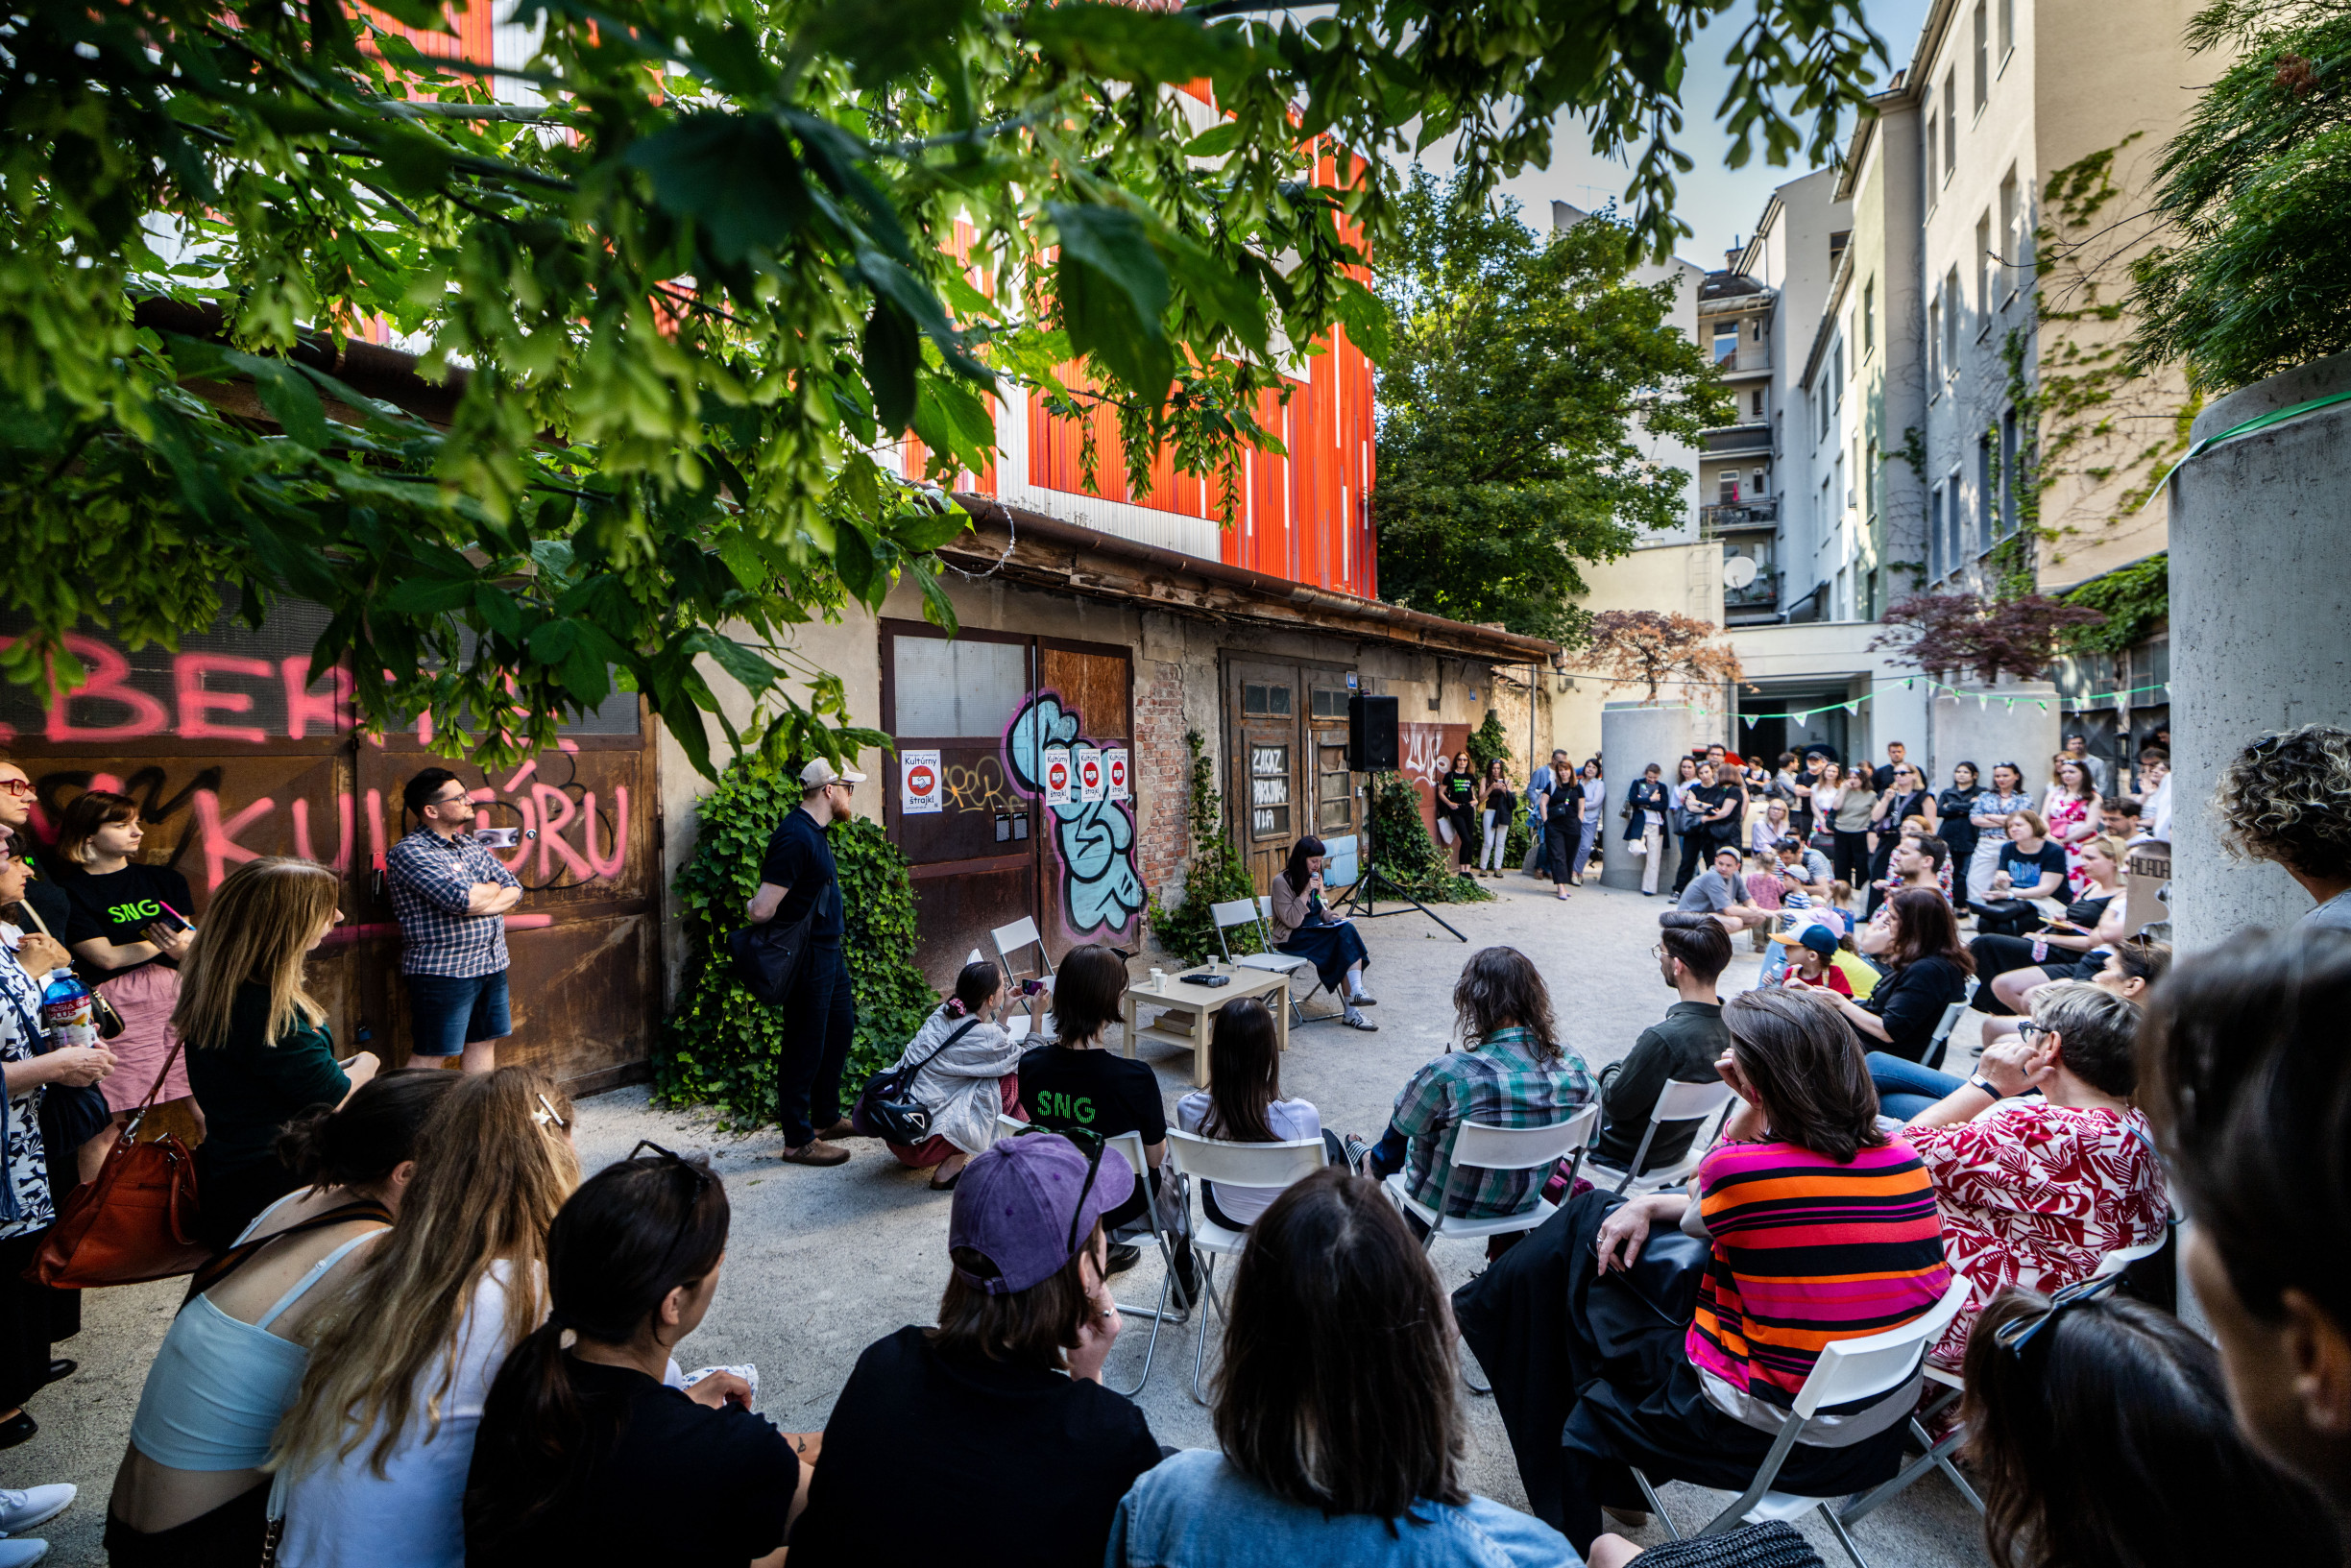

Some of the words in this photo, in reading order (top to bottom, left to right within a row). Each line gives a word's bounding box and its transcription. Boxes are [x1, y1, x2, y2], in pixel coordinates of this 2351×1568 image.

[905, 757, 937, 766] Kultúrny
[1047, 755, 1068, 763] Kultúrny
[909, 796, 934, 807] štrajk!
[108, 899, 160, 923] SNG
[1038, 1090, 1095, 1123] SNG
